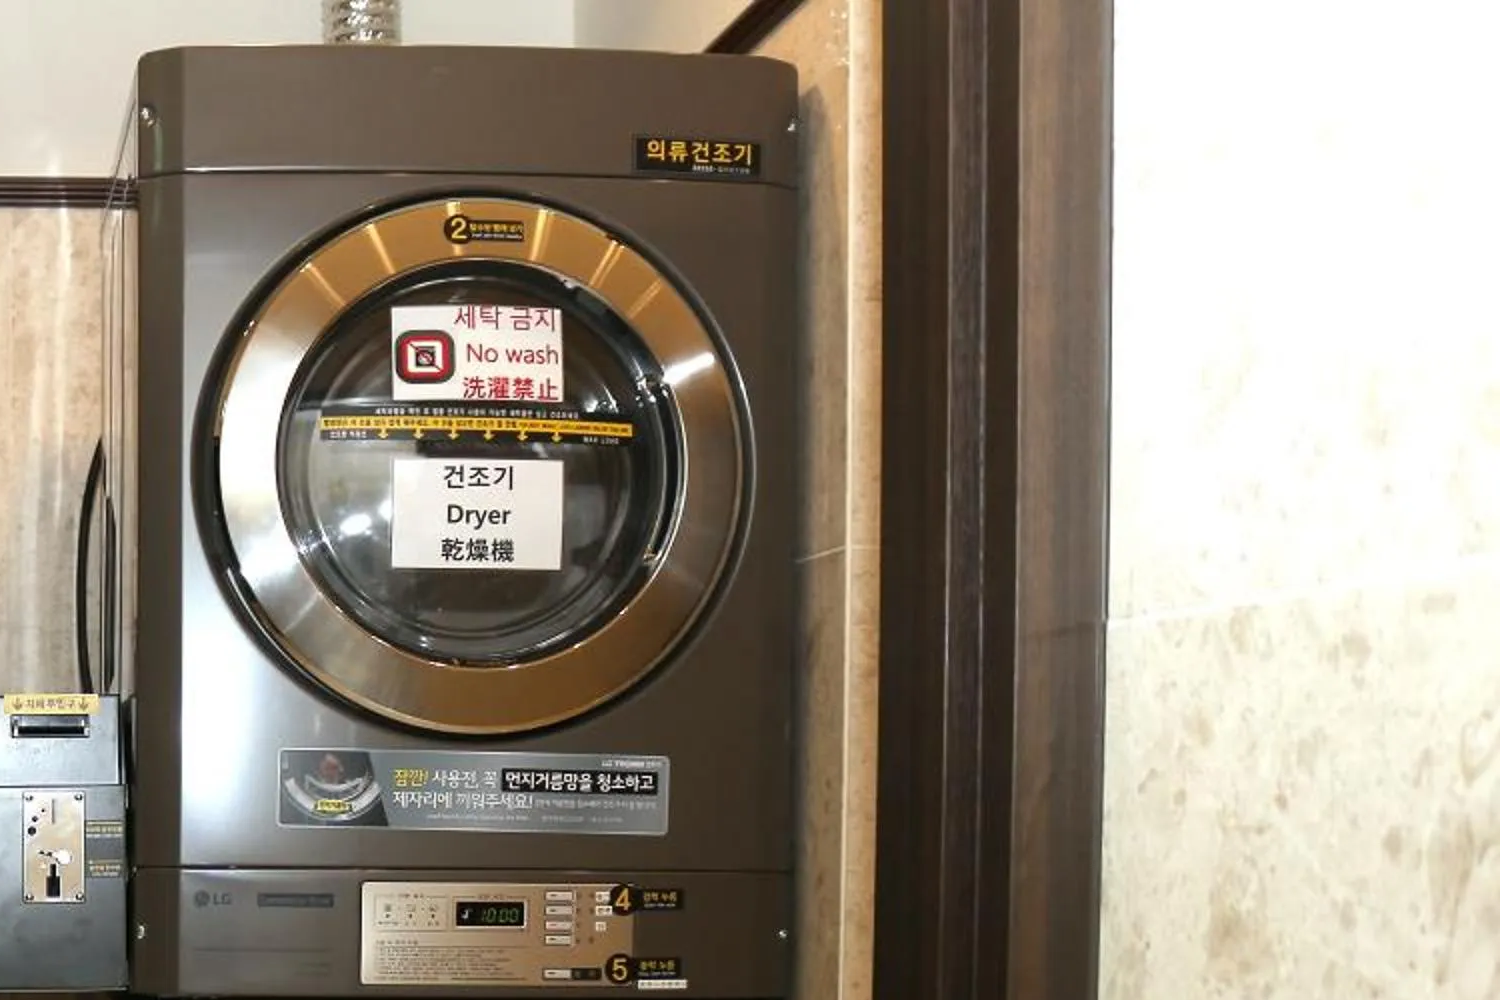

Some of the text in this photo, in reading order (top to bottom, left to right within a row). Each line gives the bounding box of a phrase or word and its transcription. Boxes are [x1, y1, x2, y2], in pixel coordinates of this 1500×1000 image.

[647, 139, 751, 166] 의류건조기
[451, 217, 468, 239] 2
[454, 304, 555, 332] 세탁 금지
[466, 343, 559, 364] No wash
[463, 376, 558, 400] 洗濯禁止
[444, 465, 513, 490] 건조기
[447, 504, 511, 530] Dryer
[441, 538, 515, 562] 乾燥機
[213, 894, 231, 906] LG
[615, 887, 631, 910] 4
[611, 958, 628, 981] 5
